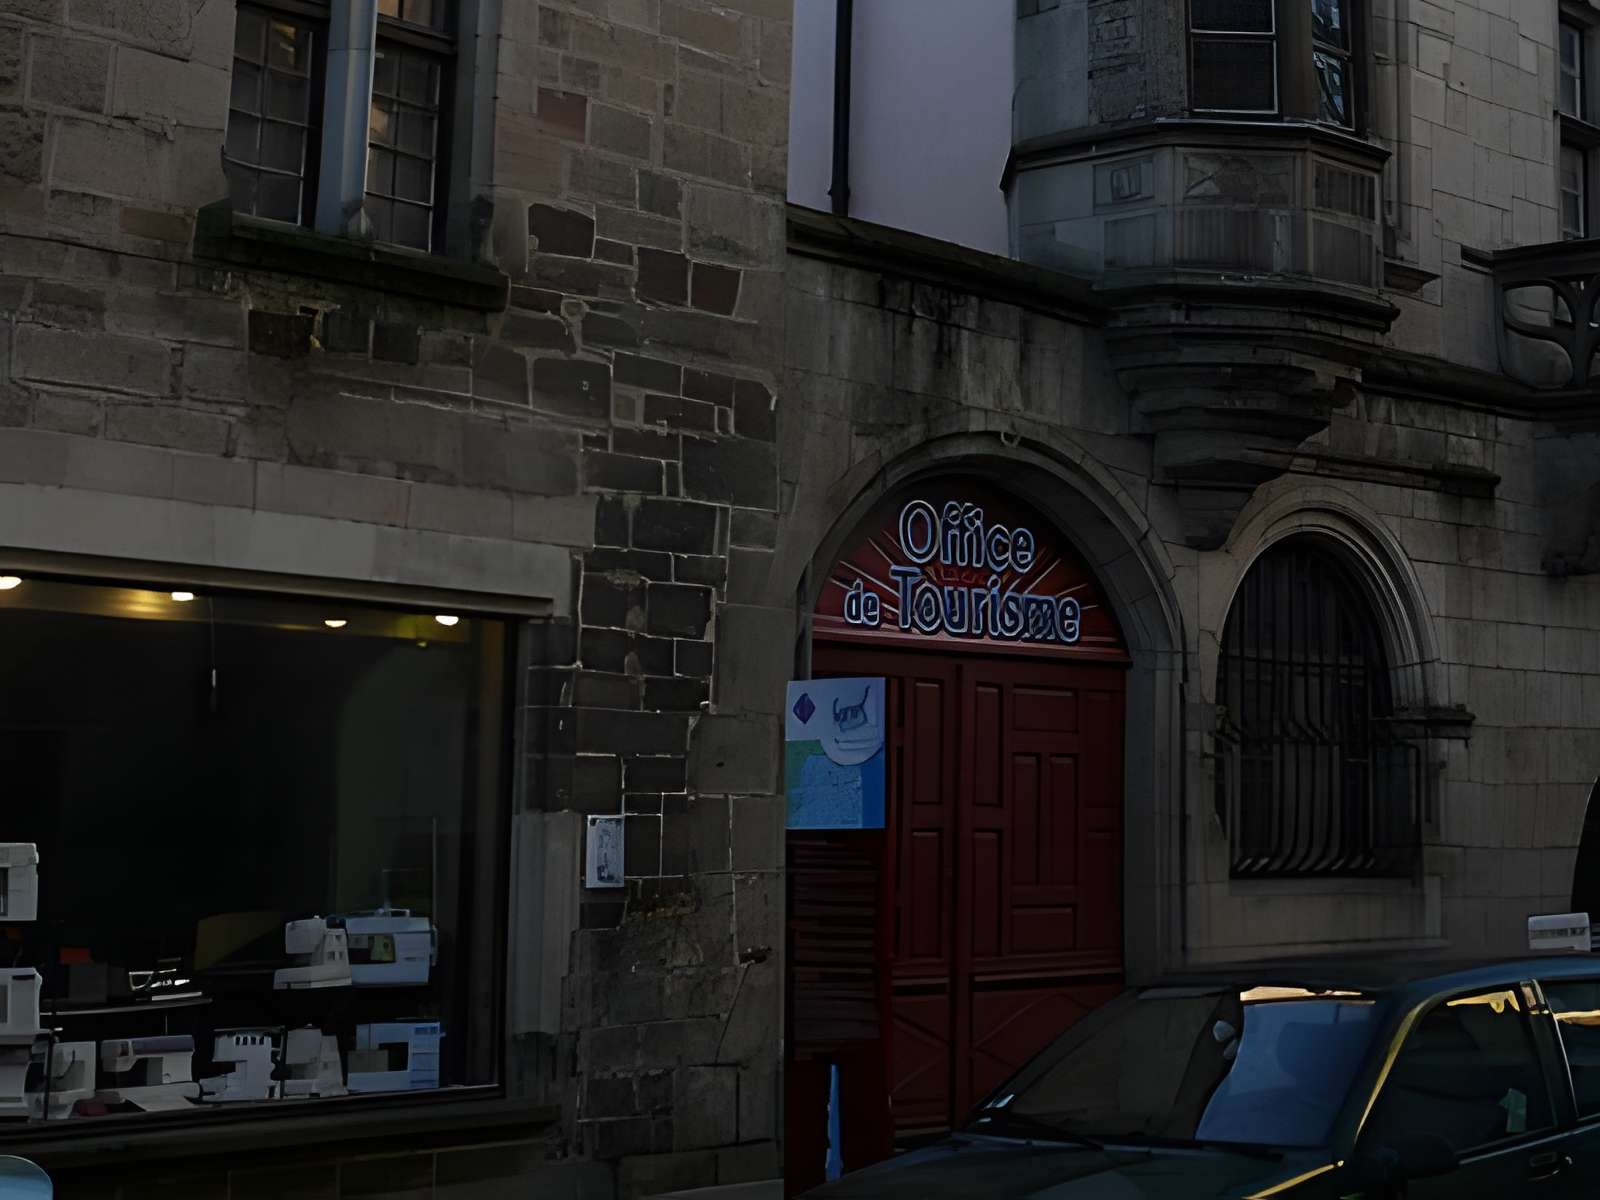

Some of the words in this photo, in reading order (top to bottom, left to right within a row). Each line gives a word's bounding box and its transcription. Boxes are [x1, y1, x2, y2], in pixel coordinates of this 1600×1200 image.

[899, 499, 1035, 573] Office
[844, 578, 880, 626] de
[889, 564, 1081, 644] Tourisme
